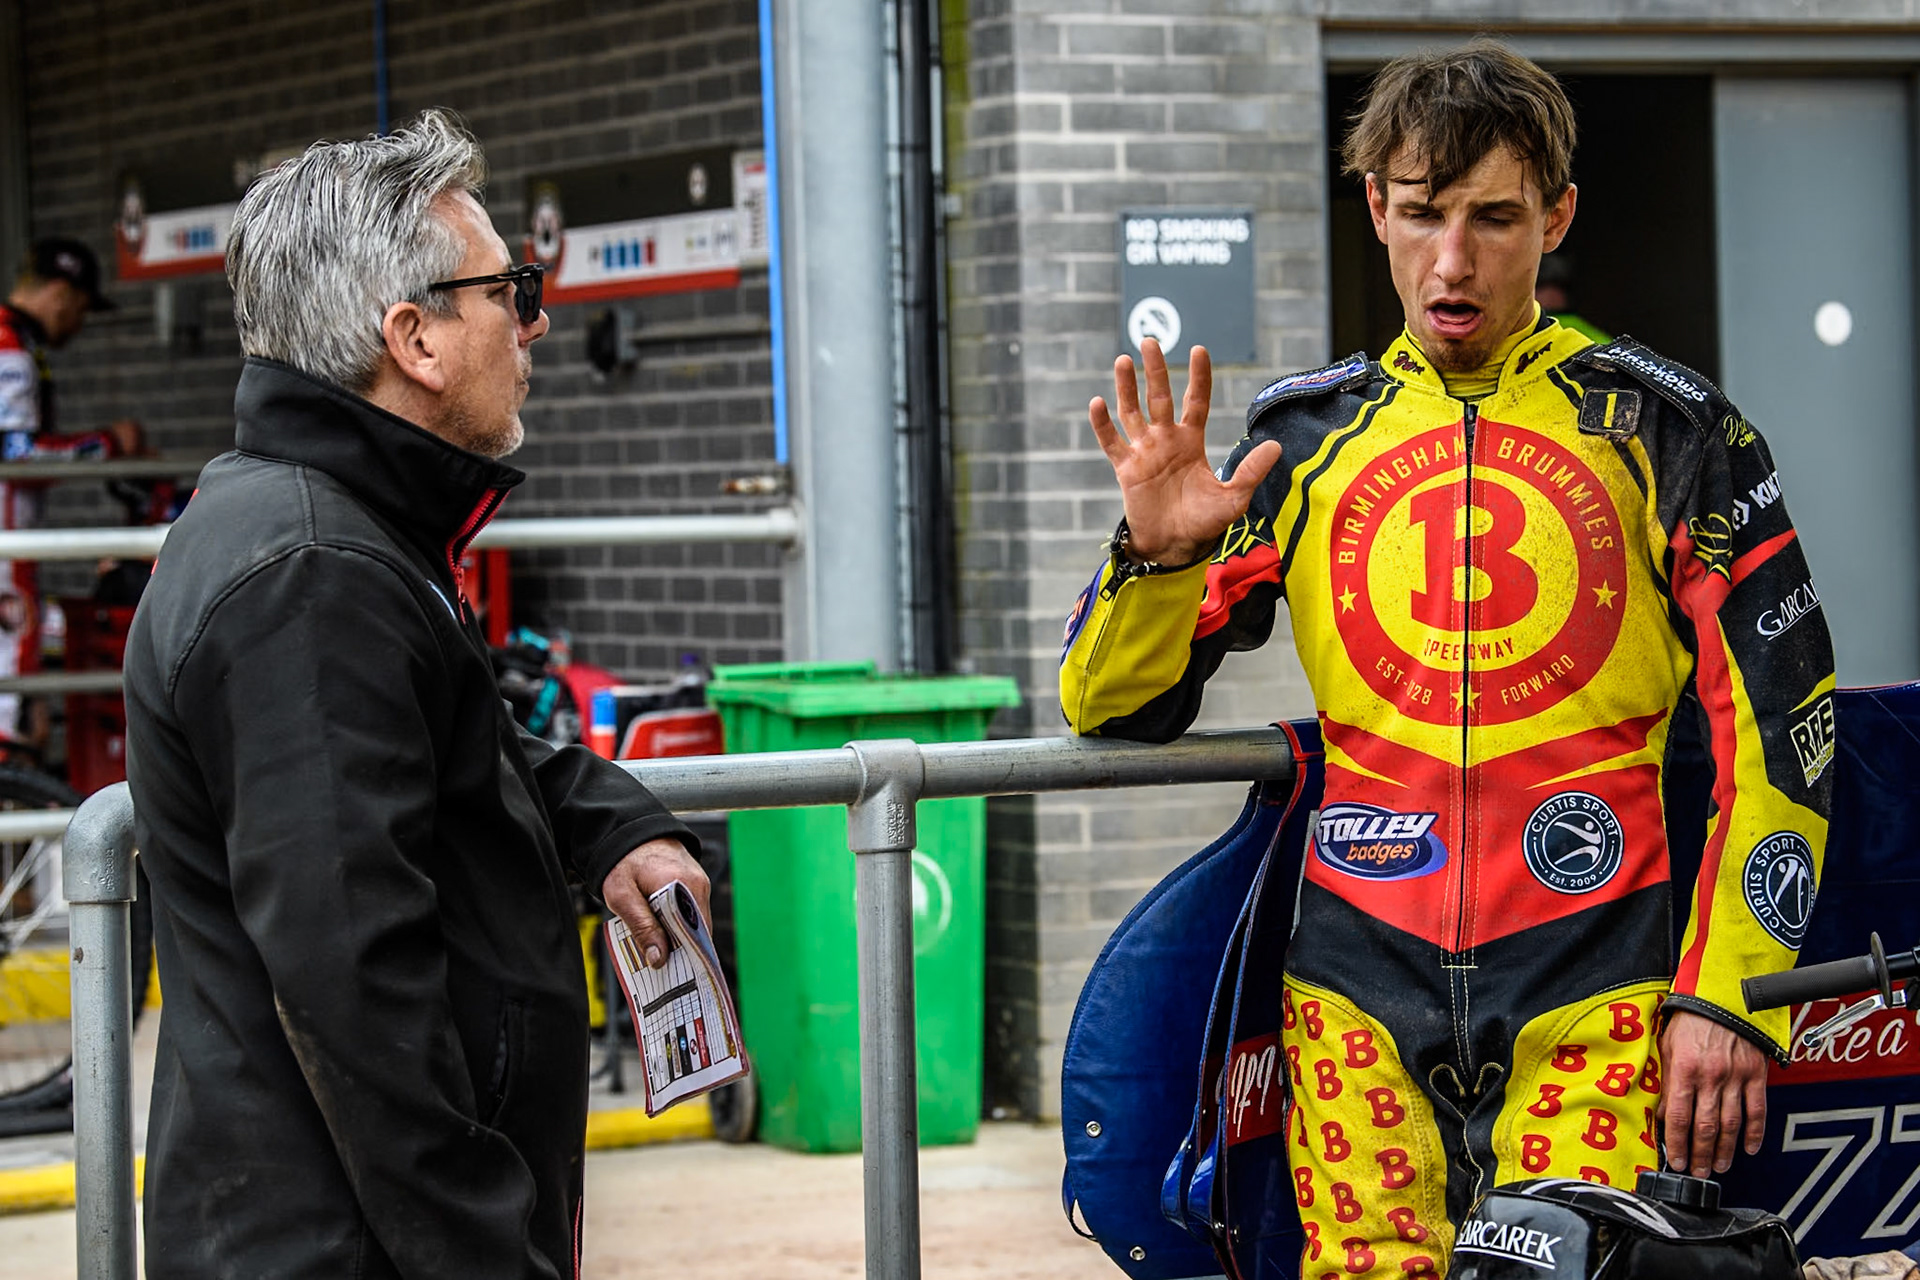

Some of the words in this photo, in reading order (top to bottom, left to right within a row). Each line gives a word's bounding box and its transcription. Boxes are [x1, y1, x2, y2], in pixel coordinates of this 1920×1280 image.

[1126, 219, 1158, 242] NO
[1159, 218, 1249, 242] SMOKING
[1126, 242, 1157, 265] OR
[1158, 241, 1231, 265] VAPING
[1338, 430, 1466, 564] BIRMINGHAM
[1496, 437, 1614, 550] BRUMMIES
[1410, 477, 1539, 632] B
[1500, 654, 1575, 705] FORWARD
[1321, 814, 1437, 843] TOLLEY
[1533, 797, 1577, 833] CURTIS
[1582, 799, 1619, 837] SPORT
[1346, 842, 1415, 865] badges
[1756, 838, 1795, 867] SPORT
[1549, 873, 1567, 887] Est.
[1570, 873, 1598, 888] 2009
[1750, 872, 1780, 929] CURTIS
[1300, 1001, 1324, 1040] B
[1608, 1002, 1644, 1042] B
[1876, 1018, 1909, 1057] a
[1341, 1029, 1378, 1069] B
[1550, 1044, 1588, 1073] B
[1314, 1059, 1343, 1100] B
[1594, 1063, 1636, 1097] B
[1364, 1087, 1405, 1128] B
[1527, 1084, 1565, 1118] B
[1320, 1121, 1351, 1162] B
[1581, 1108, 1618, 1151] B
[1375, 1148, 1416, 1189] B
[1521, 1134, 1552, 1173] B
[1295, 1166, 1314, 1208] B
[1330, 1182, 1363, 1223] B
[1386, 1207, 1428, 1243] B
[1456, 1220, 1561, 1264] ARCAREK
[1341, 1237, 1376, 1274] B
